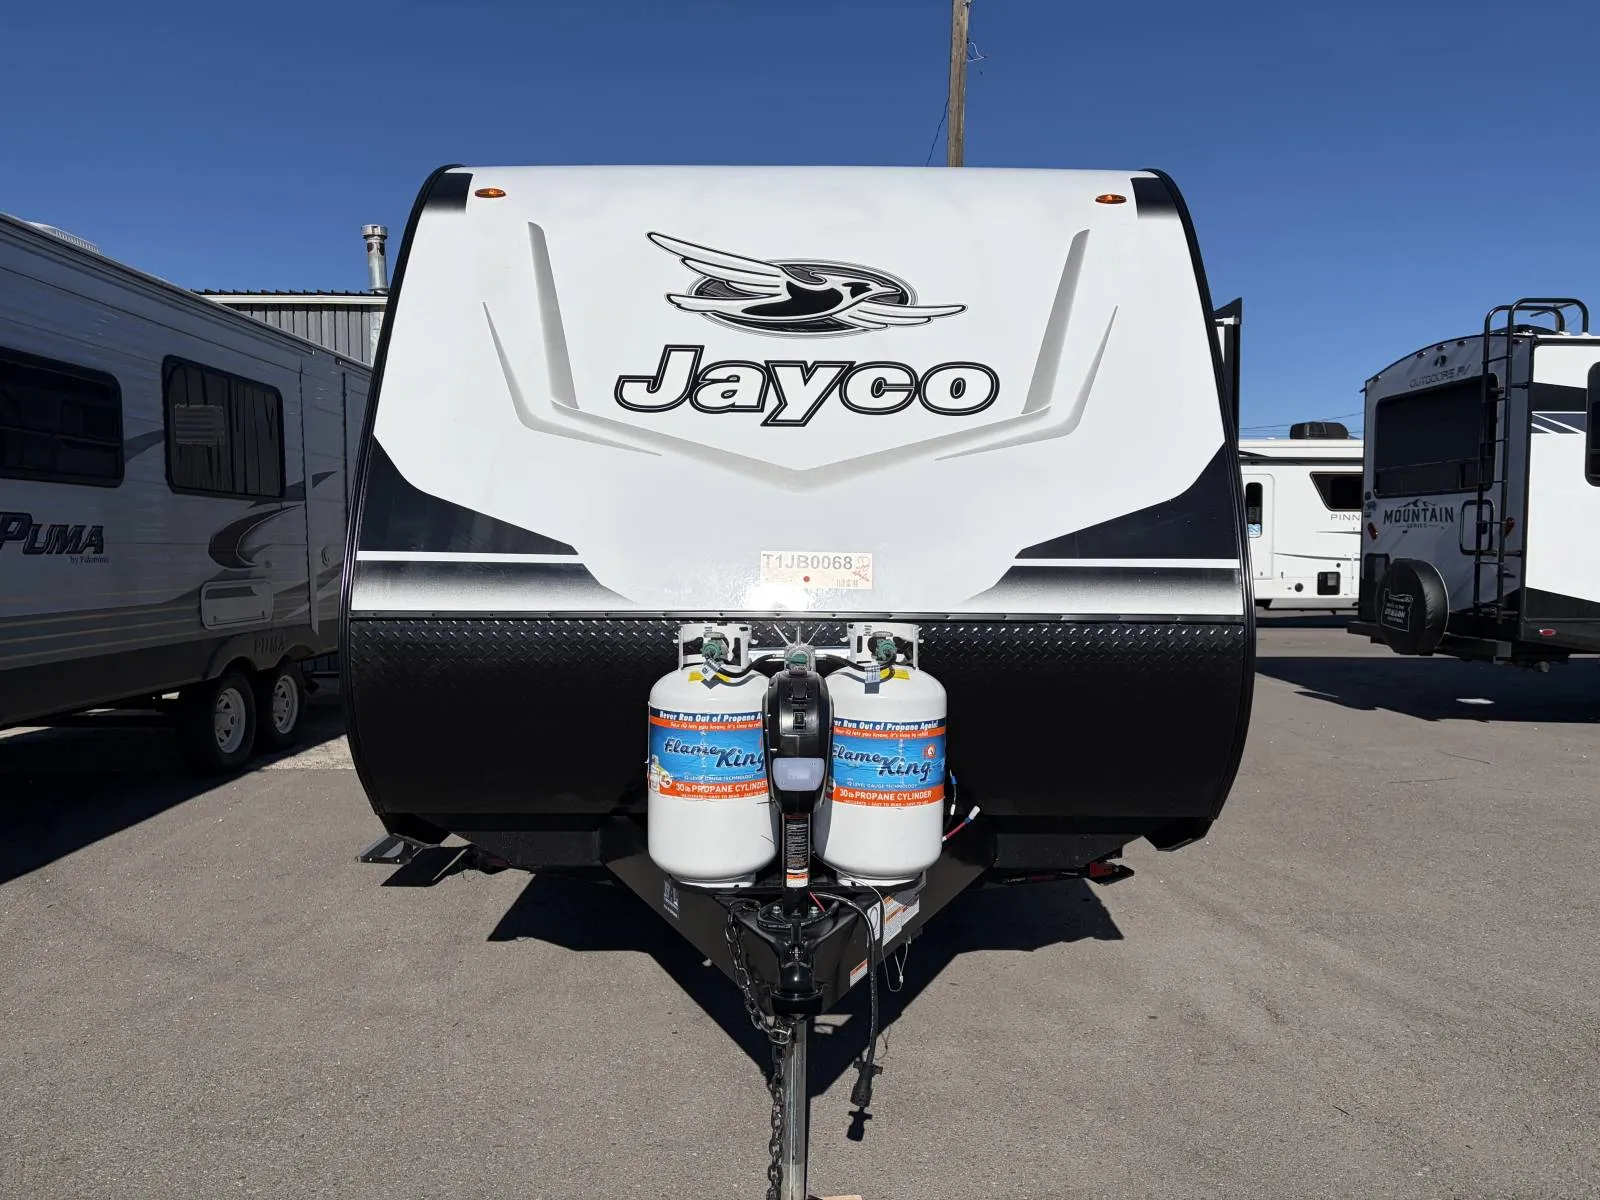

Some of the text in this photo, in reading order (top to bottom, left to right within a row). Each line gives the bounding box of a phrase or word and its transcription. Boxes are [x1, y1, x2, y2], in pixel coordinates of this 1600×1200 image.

[613, 344, 1001, 427] Jayco
[1330, 513, 1361, 521] PINN
[1383, 506, 1455, 525] MOUNTAIN
[0, 511, 104, 555] PUMA
[762, 553, 853, 570] T1JB0068
[659, 711, 677, 720] Never
[679, 713, 693, 722] Run
[695, 714, 710, 722] Out
[712, 714, 721, 722] of
[723, 713, 755, 723] Propane
[843, 720, 857, 729] Run
[859, 722, 874, 730] Out
[875, 722, 885, 731] of
[886, 723, 919, 732] Propane
[664, 737, 721, 756] Flame
[716, 748, 765, 773] King
[878, 756, 933, 782] King
[692, 784, 734, 793] PROPANE
[855, 790, 895, 801] PROPANE
[897, 790, 932, 800] CYLINDER
